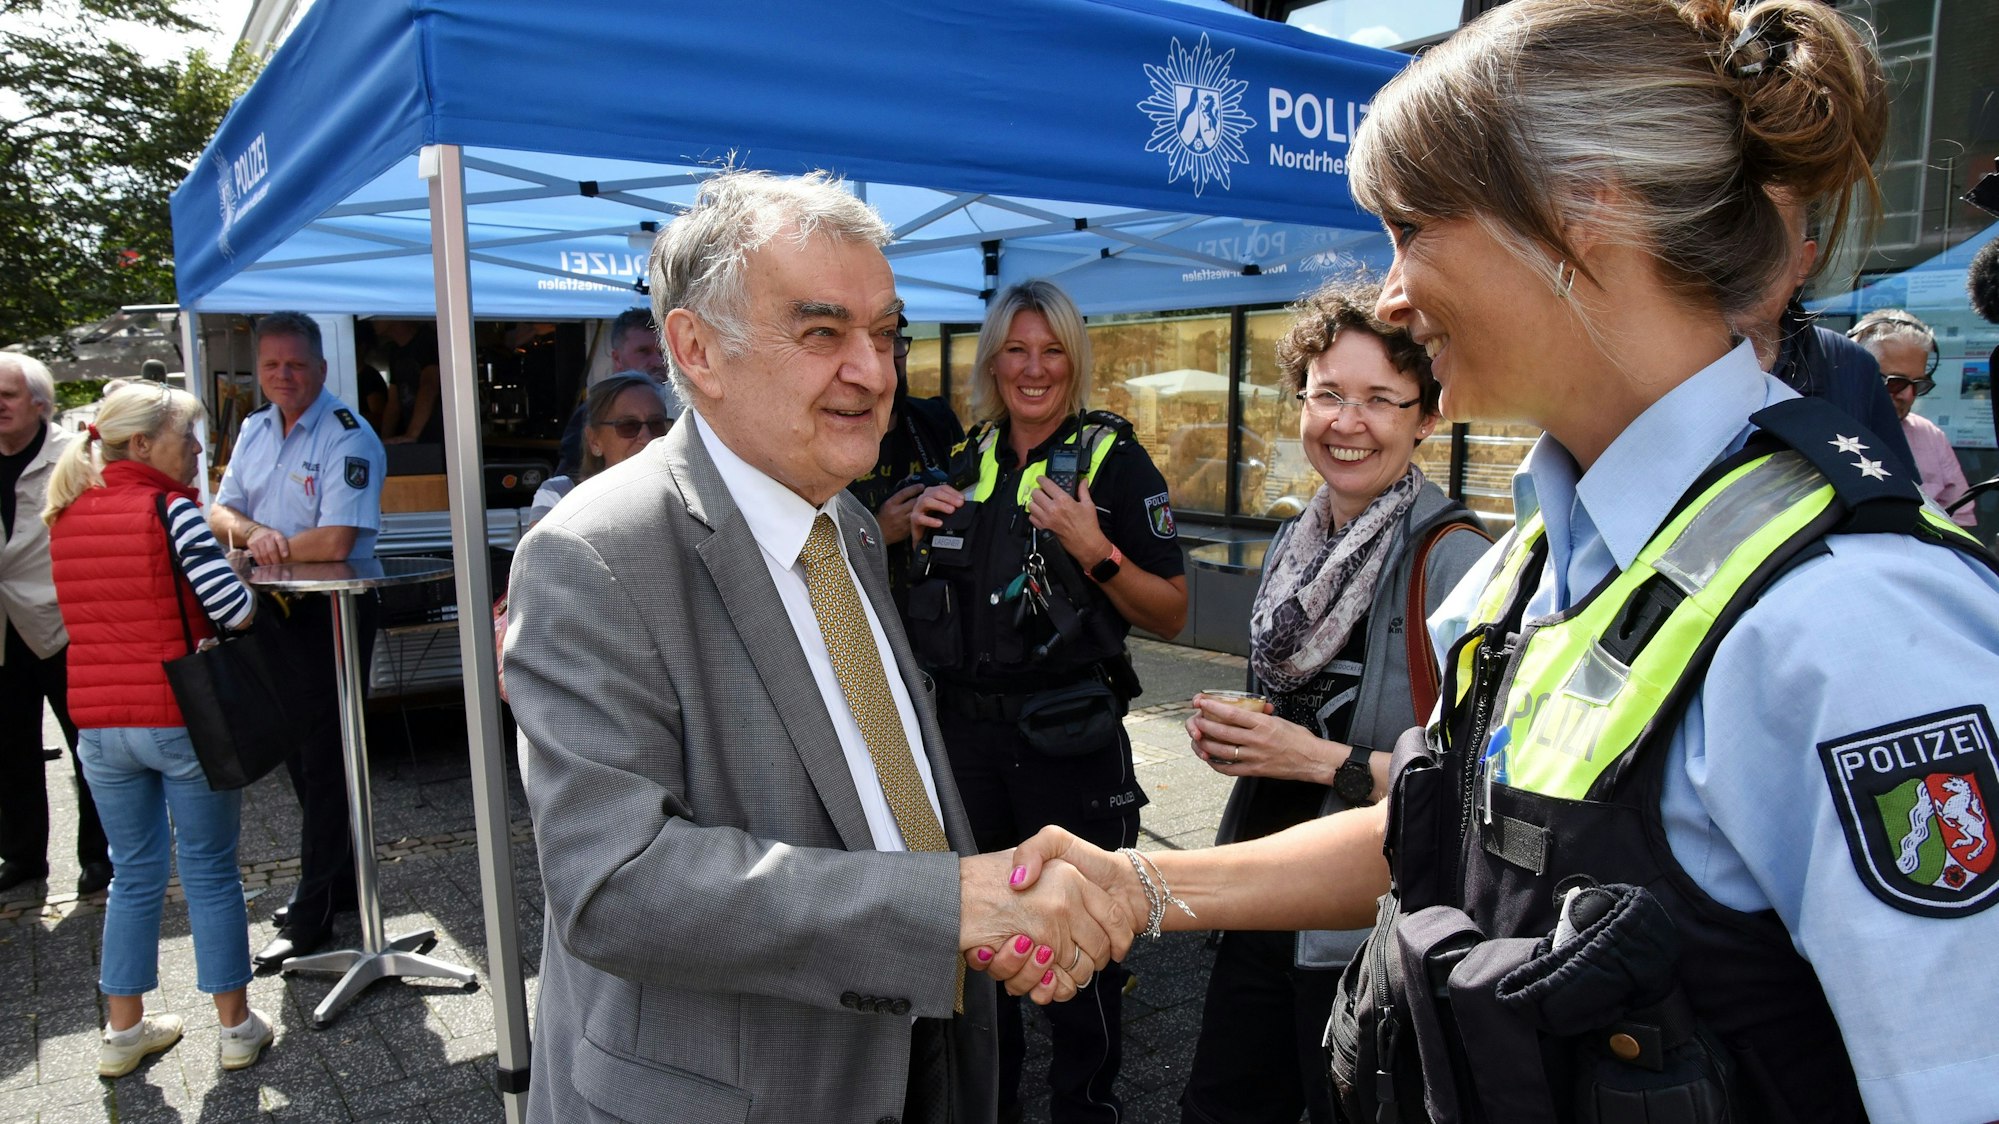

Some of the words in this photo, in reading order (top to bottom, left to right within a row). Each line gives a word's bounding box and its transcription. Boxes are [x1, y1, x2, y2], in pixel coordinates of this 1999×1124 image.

[233, 131, 269, 200] POLIZEI
[1309, 679, 1335, 692] our
[1841, 723, 1984, 781] POLIZEI
